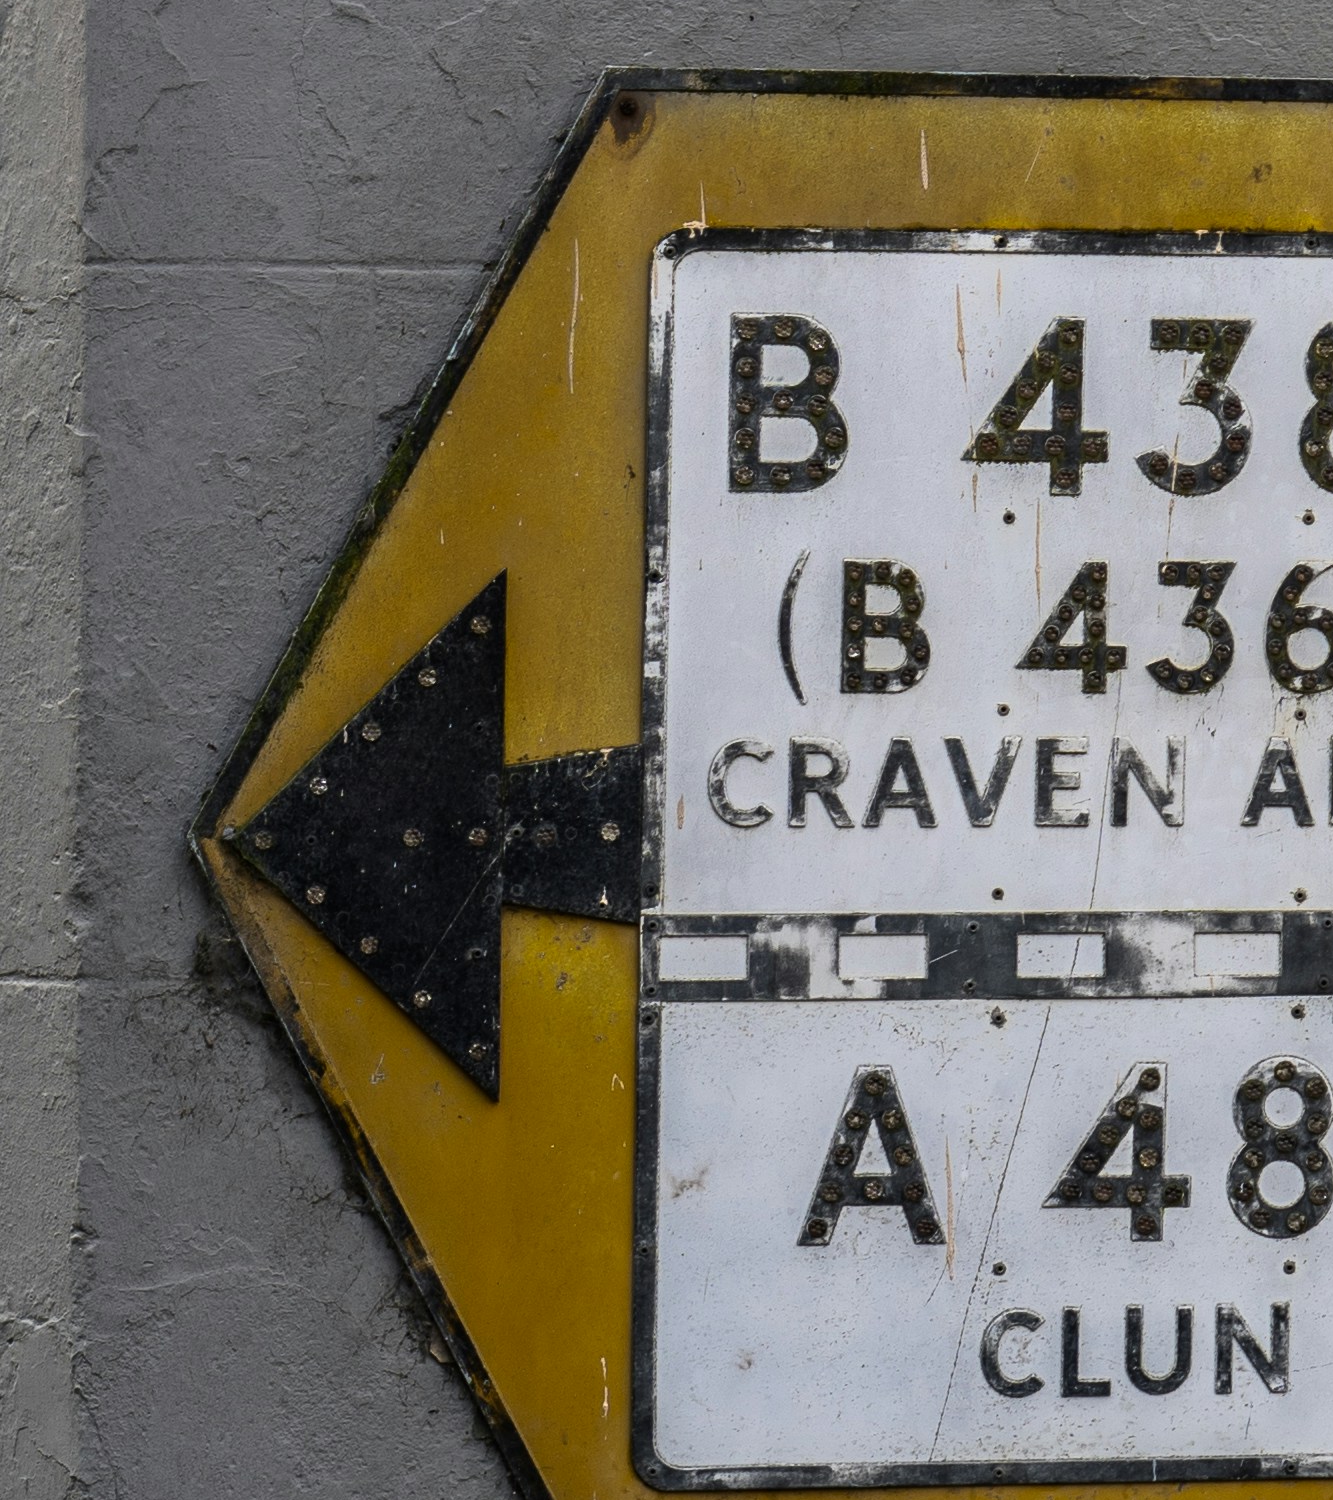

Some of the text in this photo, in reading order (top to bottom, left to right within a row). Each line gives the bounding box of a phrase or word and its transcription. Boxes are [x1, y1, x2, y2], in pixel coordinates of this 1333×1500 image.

[729, 312, 851, 494] B
[777, 549, 931, 706] (B
[709, 735, 1186, 828] CRAVEN
[797, 1063, 946, 1247] A
[978, 1302, 1291, 1399] CLUN
